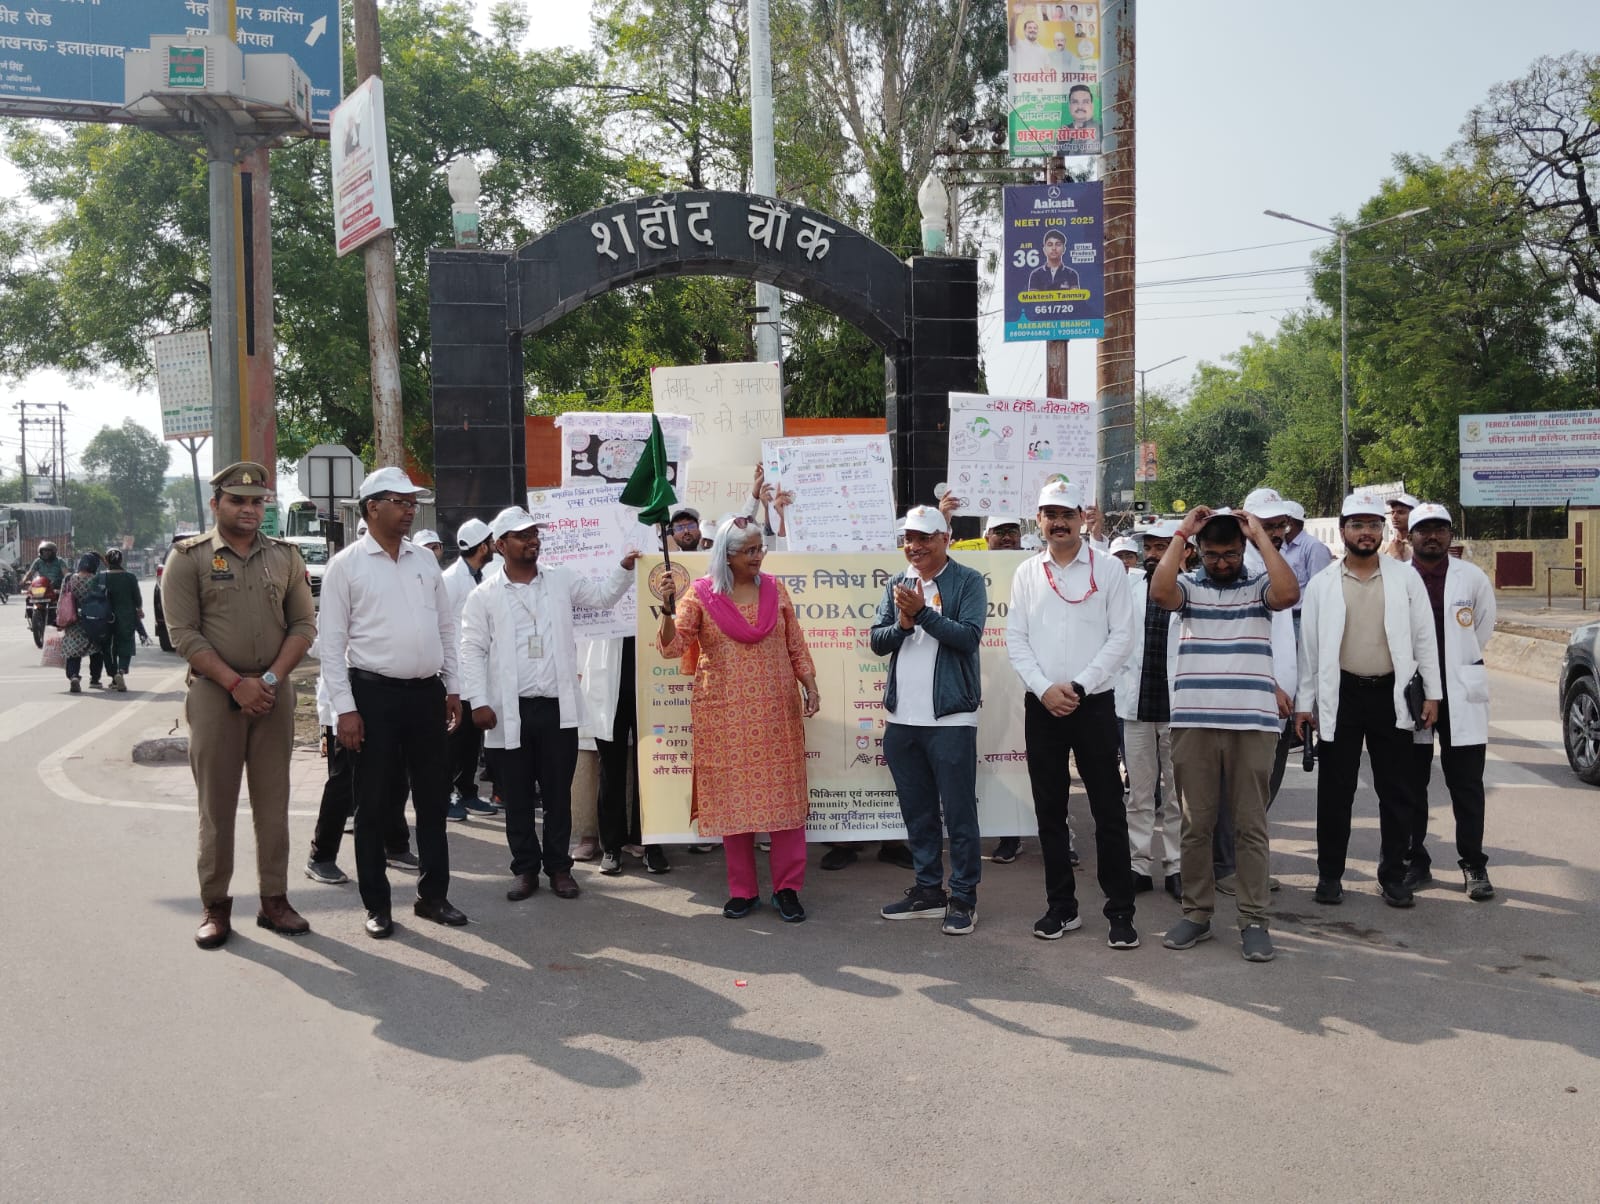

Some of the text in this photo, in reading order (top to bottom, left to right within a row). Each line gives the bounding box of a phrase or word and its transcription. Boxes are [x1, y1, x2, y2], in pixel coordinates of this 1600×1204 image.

[25, 8, 52, 26] रोड
[184, 0, 304, 24] नेह गर क्रासिंग
[1013, 69, 1097, 83] रायबरेली आगमन
[1057, 126, 1096, 141] सोनकर
[1034, 198, 1075, 209] Aakash
[1014, 216, 1095, 227] NEET (UG) 2025
[747, 199, 837, 262] चौक
[1013, 249, 1040, 268] 36
[1022, 292, 1086, 300] Muktesh Tanmay
[1035, 304, 1074, 314] 661/720
[1512, 420, 1537, 428] GANDHI
[1571, 431, 1600, 441] रायबरे
[813, 568, 867, 589] निषेध
[794, 602, 1009, 620] TOBAC 20
[807, 627, 839, 640] तंबाकू
[842, 625, 857, 637] की
[653, 666, 680, 677] Oral
[859, 664, 889, 673] Walk
[653, 698, 690, 706] in collab
[668, 725, 679, 734] 27
[666, 739, 688, 747] OPD
[652, 751, 689, 763] तंबाकू से
[984, 750, 1028, 763] रायबरेल
[653, 765, 670, 775] और
[810, 788, 847, 798] चिकित्सा
[849, 789, 862, 798] एवं
[808, 799, 894, 809] mmunity Medicine
[829, 811, 875, 823] आयुर्विज्ञान
[877, 811, 902, 821] संस्था
[829, 822, 839, 830] of
[841, 821, 879, 830] Medical
[881, 821, 906, 830] Scien
